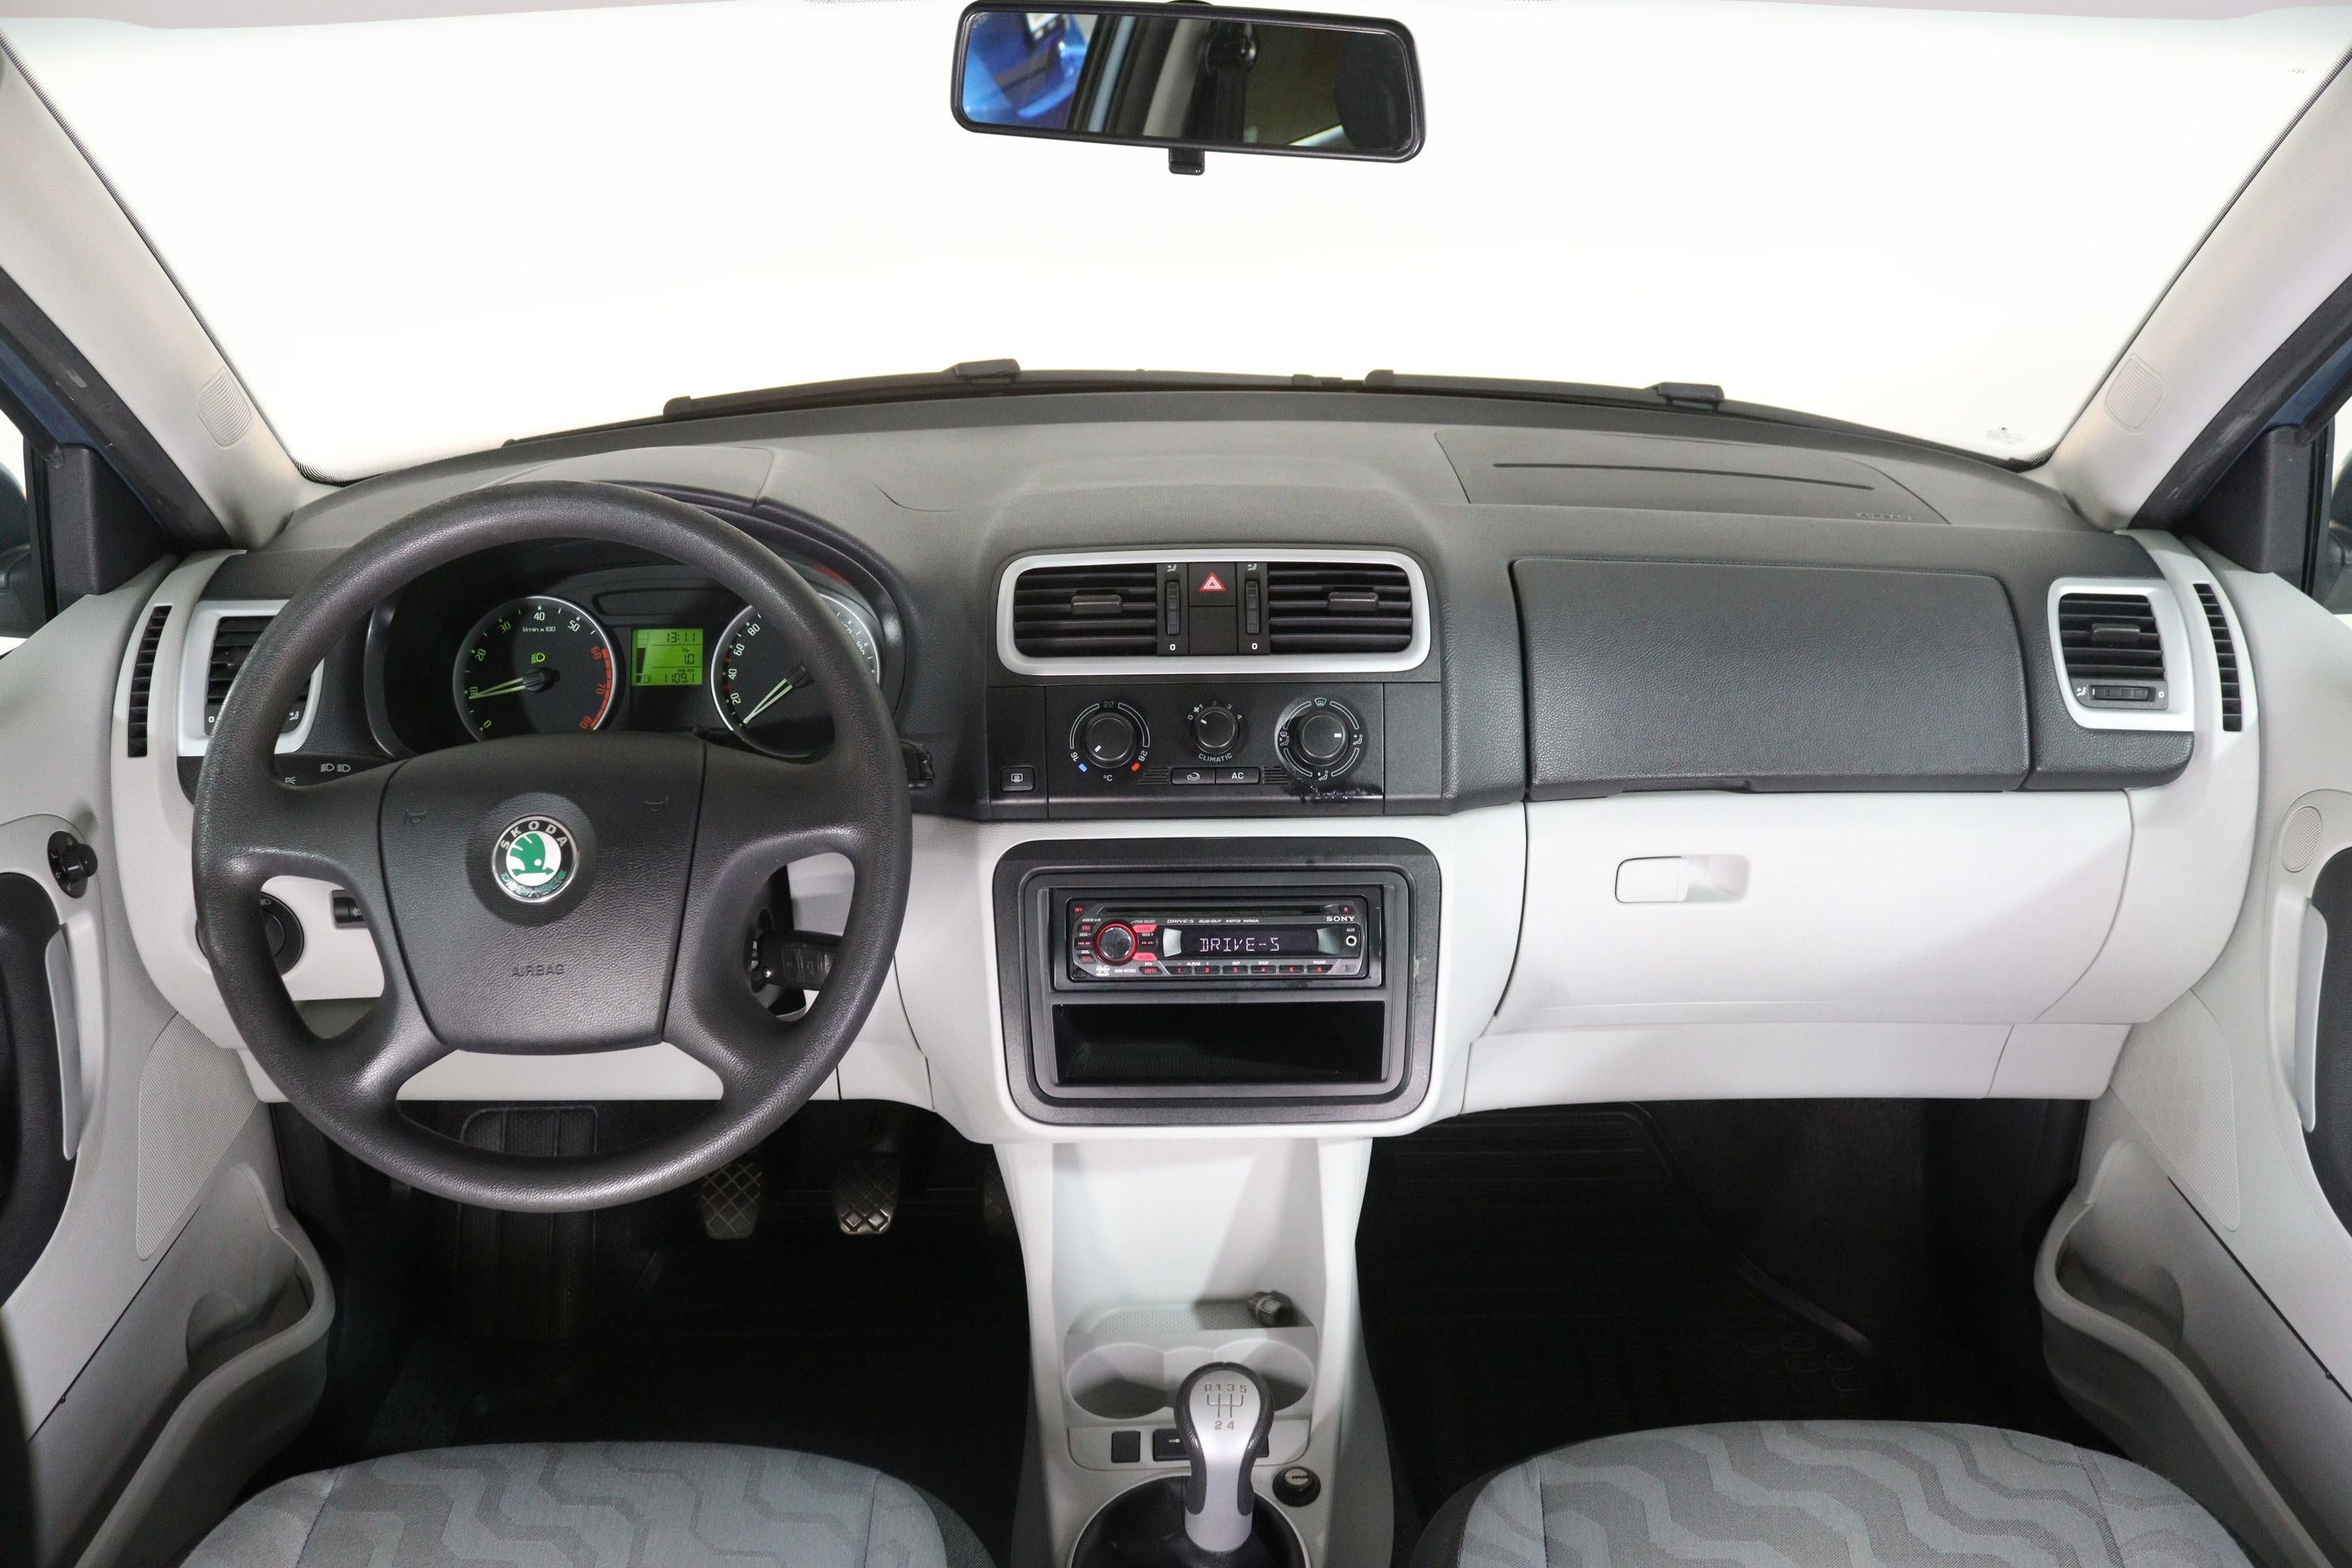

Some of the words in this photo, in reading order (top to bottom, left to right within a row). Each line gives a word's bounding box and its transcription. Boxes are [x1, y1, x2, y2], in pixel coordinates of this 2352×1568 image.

[533, 612, 545, 621] 40
[499, 622, 511, 633] 30
[567, 620, 580, 632] 50
[747, 623, 761, 636] 80
[667, 631, 695, 643] 13:11
[475, 648, 487, 662] 20
[590, 646, 602, 660] 60
[733, 643, 745, 657] 60
[728, 668, 737, 680] 40
[596, 684, 606, 695] 70
[729, 692, 741, 706] 20
[483, 719, 492, 729] 0
[579, 716, 593, 729] 80
[1070, 752, 1080, 762] 16
[1138, 750, 1148, 762] 28
[1198, 752, 1233, 763] CLIMATIC
[499, 820, 568, 850] SKODA
[1200, 937, 1280, 952] DRIVE-S
[1240, 1385, 1247, 1393] 5
[1215, 1420, 1222, 1430] 2
[1227, 1421, 1234, 1430] 4
